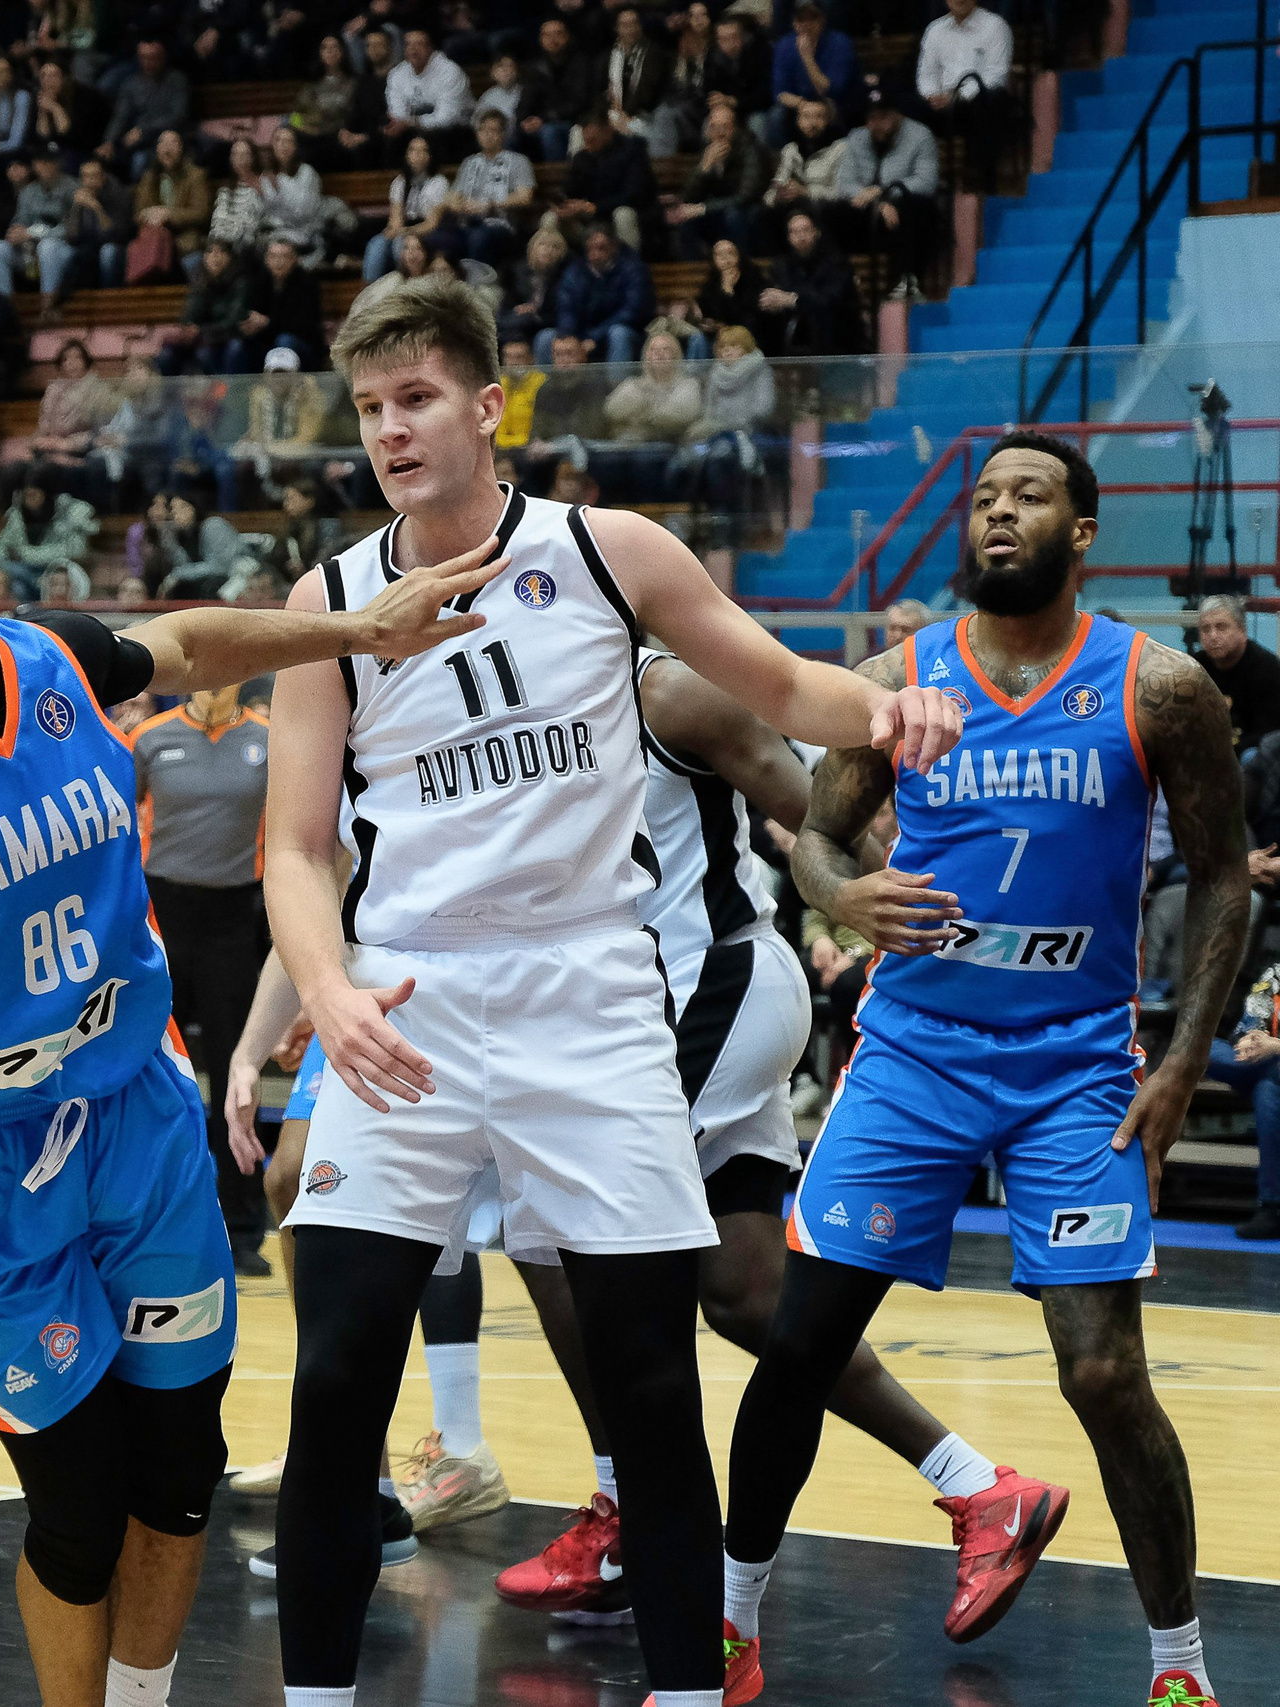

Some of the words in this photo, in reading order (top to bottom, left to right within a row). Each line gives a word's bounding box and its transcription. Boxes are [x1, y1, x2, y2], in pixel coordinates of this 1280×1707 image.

[443, 640, 528, 722] 11
[415, 720, 599, 806] AVTODOR
[925, 748, 1106, 808] SAMARA
[998, 828, 1030, 893] 7
[22, 894, 99, 995] 86
[823, 1213, 850, 1228] PEAK
[4, 1372, 39, 1394] PEAK
